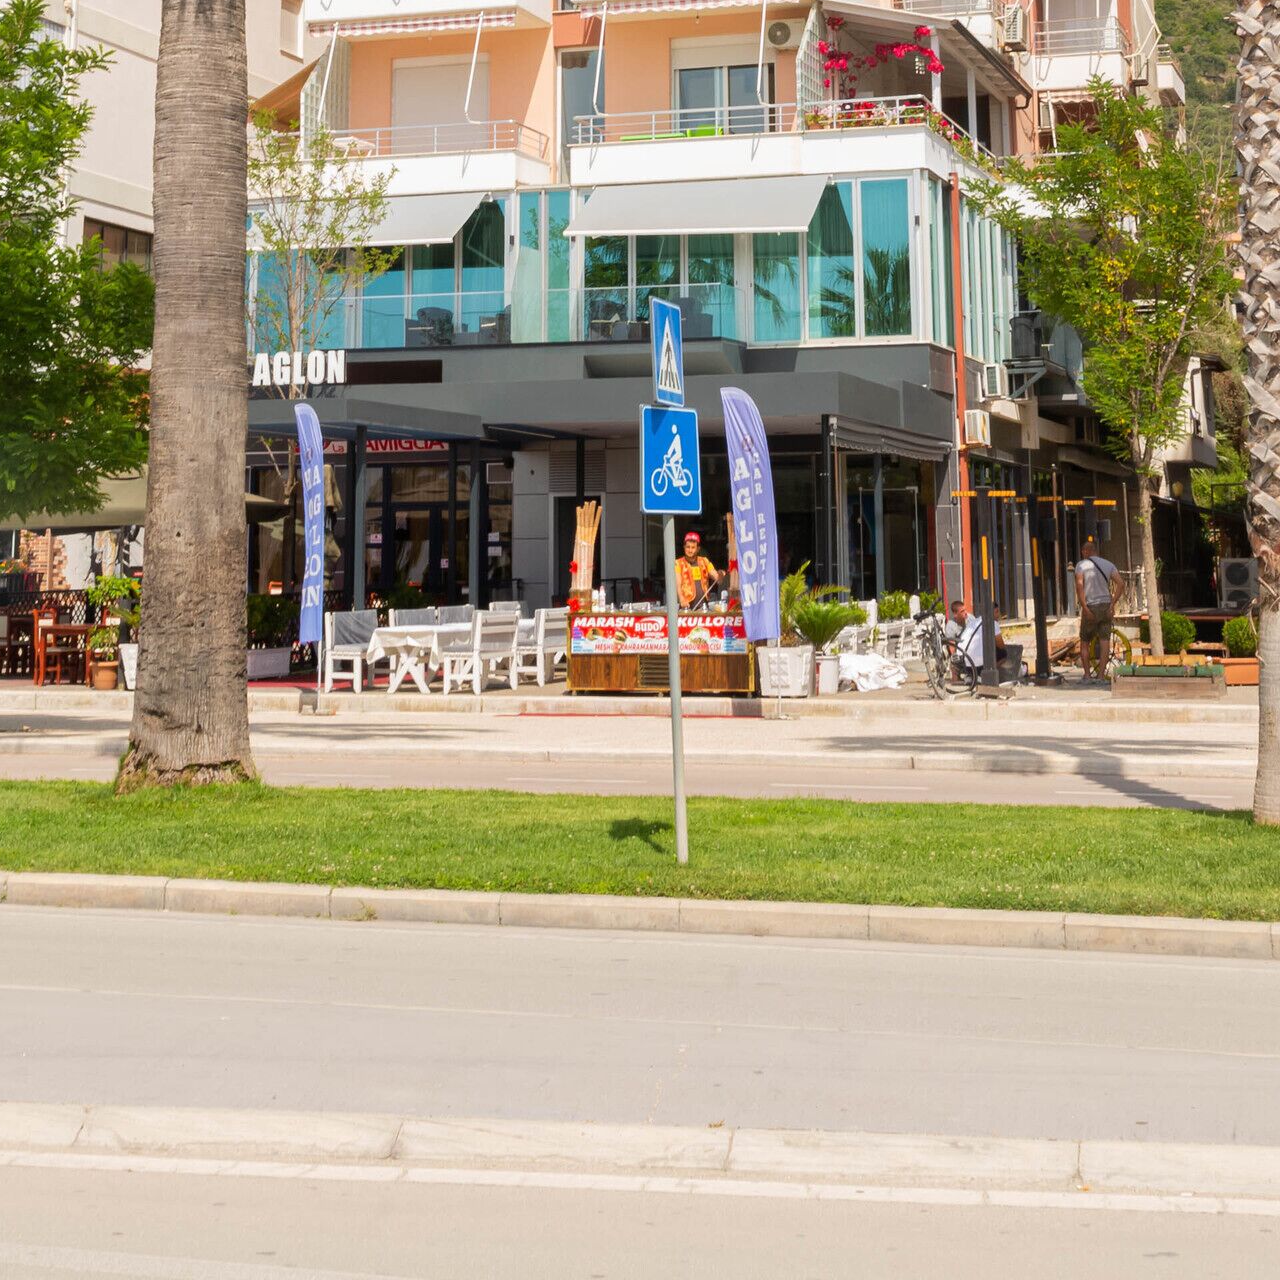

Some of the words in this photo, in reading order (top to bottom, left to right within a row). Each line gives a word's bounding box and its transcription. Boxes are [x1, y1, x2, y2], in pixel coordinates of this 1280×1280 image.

[252, 349, 346, 387] AGLON
[366, 438, 445, 452] AMIGLIA
[753, 452, 762, 495] CAR
[306, 465, 322, 607] AGLON
[733, 456, 758, 608] AGLON
[574, 616, 634, 628] MARASH
[666, 616, 743, 627] KULLORE
[634, 622, 659, 632] BUDO
